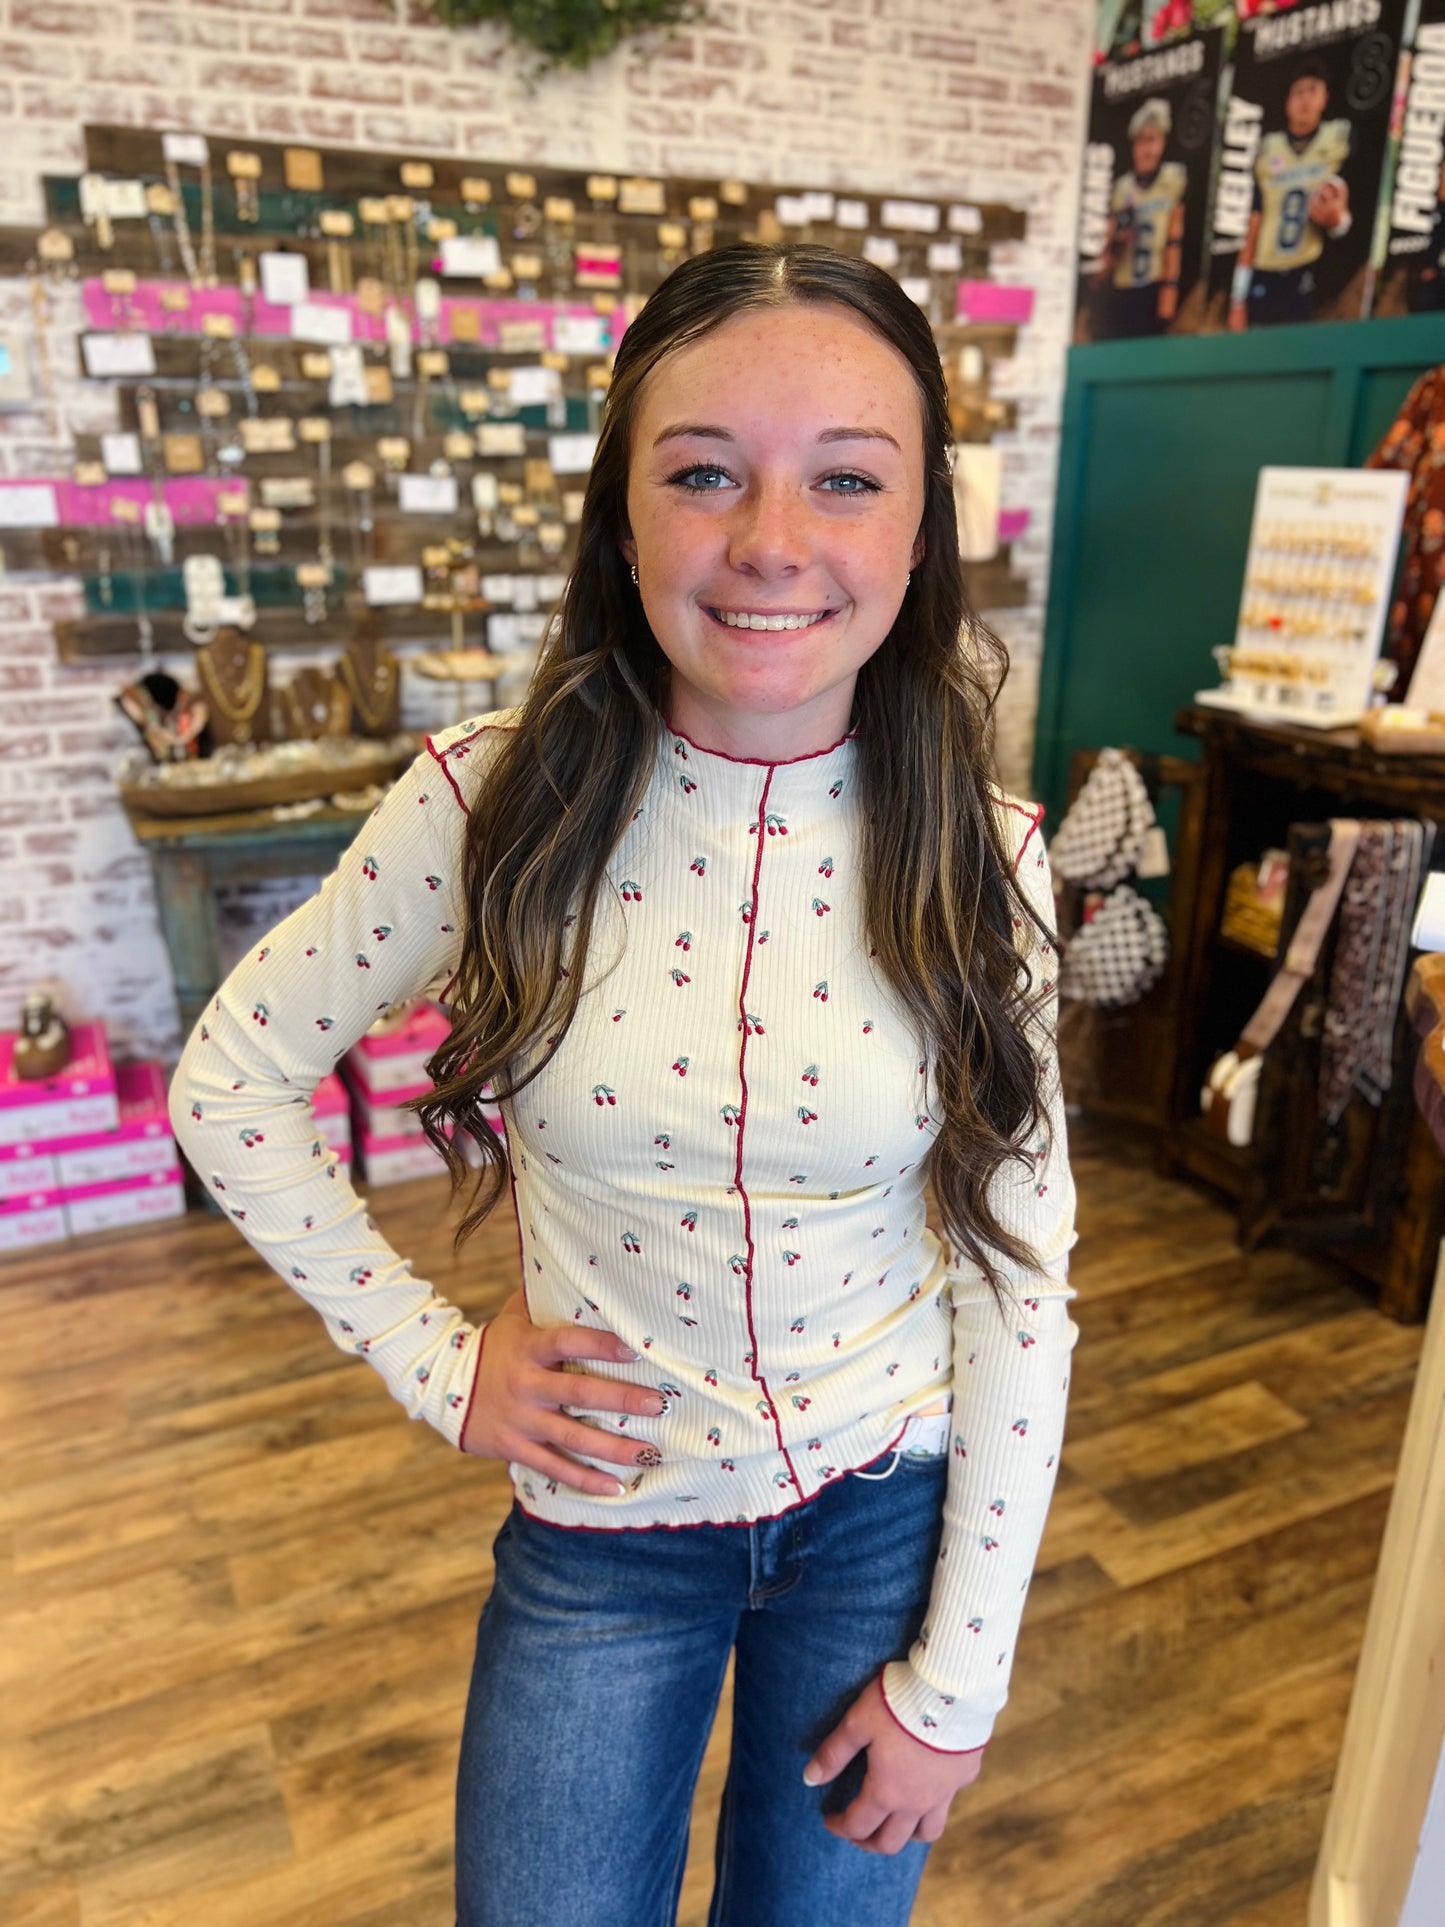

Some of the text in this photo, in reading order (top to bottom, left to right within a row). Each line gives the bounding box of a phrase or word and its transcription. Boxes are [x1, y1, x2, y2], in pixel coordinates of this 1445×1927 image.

[1243, 0, 1381, 57] MUSTANGS
[1213, 96, 1264, 237] KELLEY
[1277, 188, 1309, 254] 8
